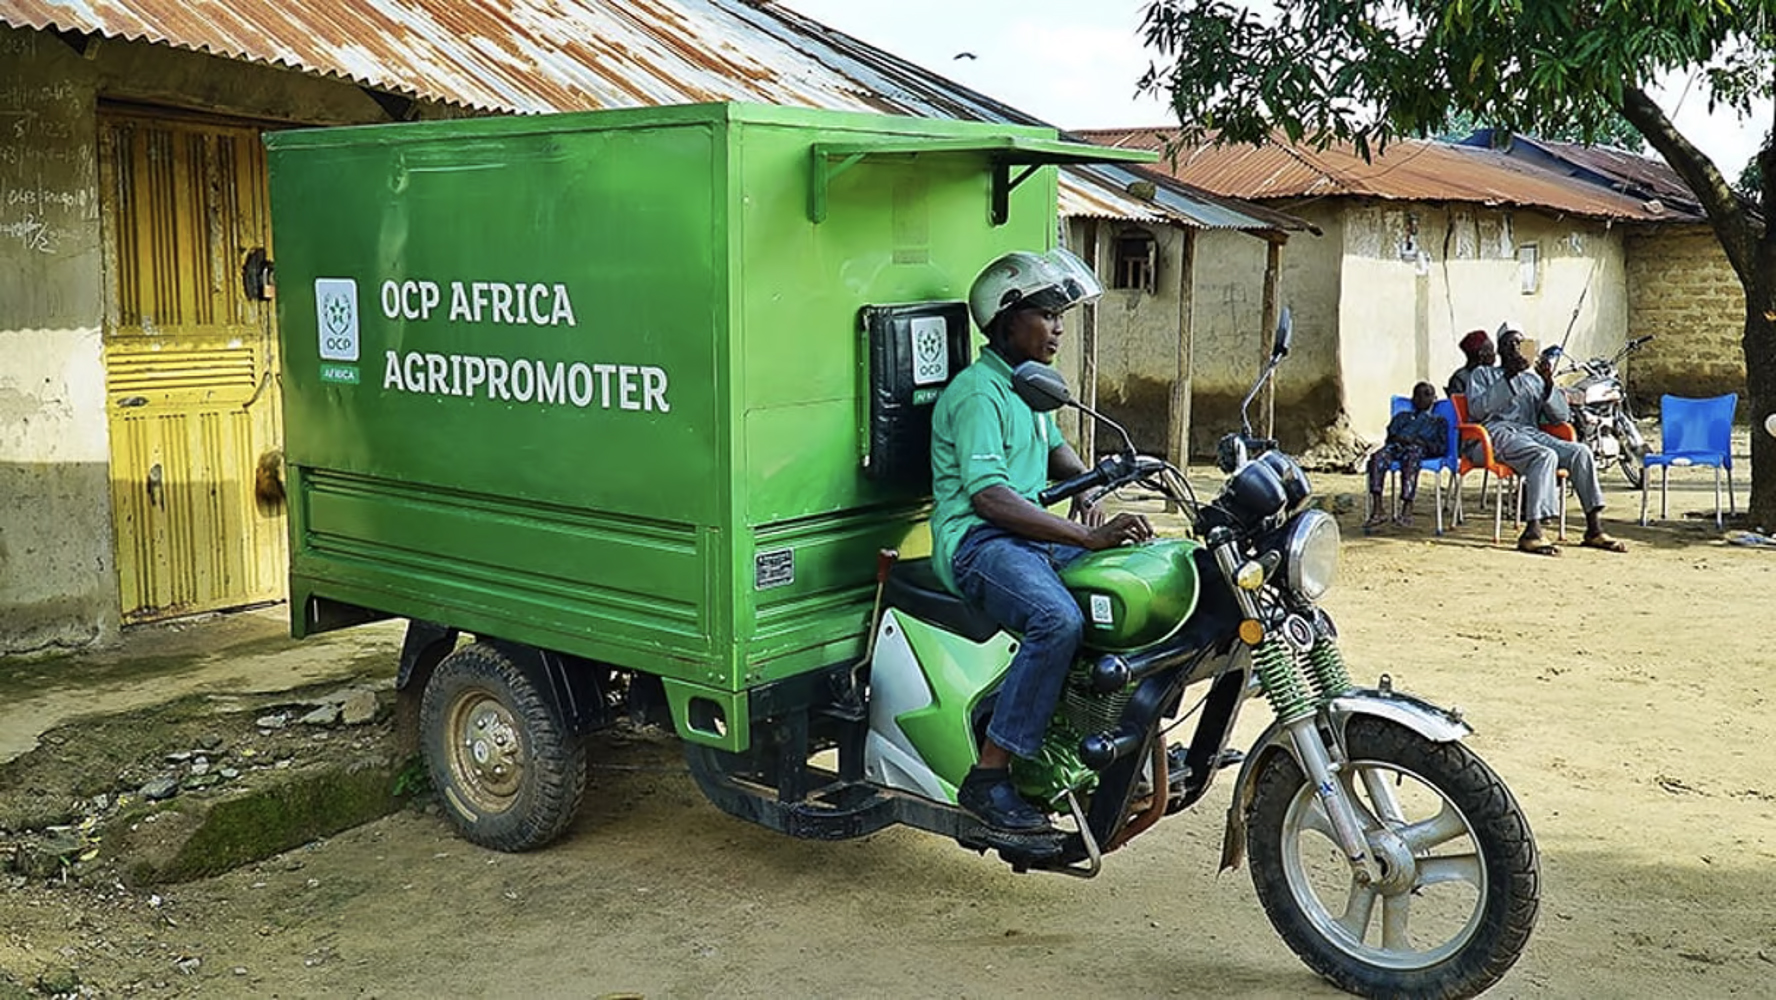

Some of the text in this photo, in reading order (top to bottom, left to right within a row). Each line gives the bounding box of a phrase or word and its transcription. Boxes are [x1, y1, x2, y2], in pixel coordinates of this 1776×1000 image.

[381, 279, 576, 326] OCP AFRICA
[326, 337, 351, 350] OCP
[324, 367, 356, 381] AFRICA
[919, 364, 942, 376] OCP
[383, 350, 671, 413] AGRIPROMOTER
